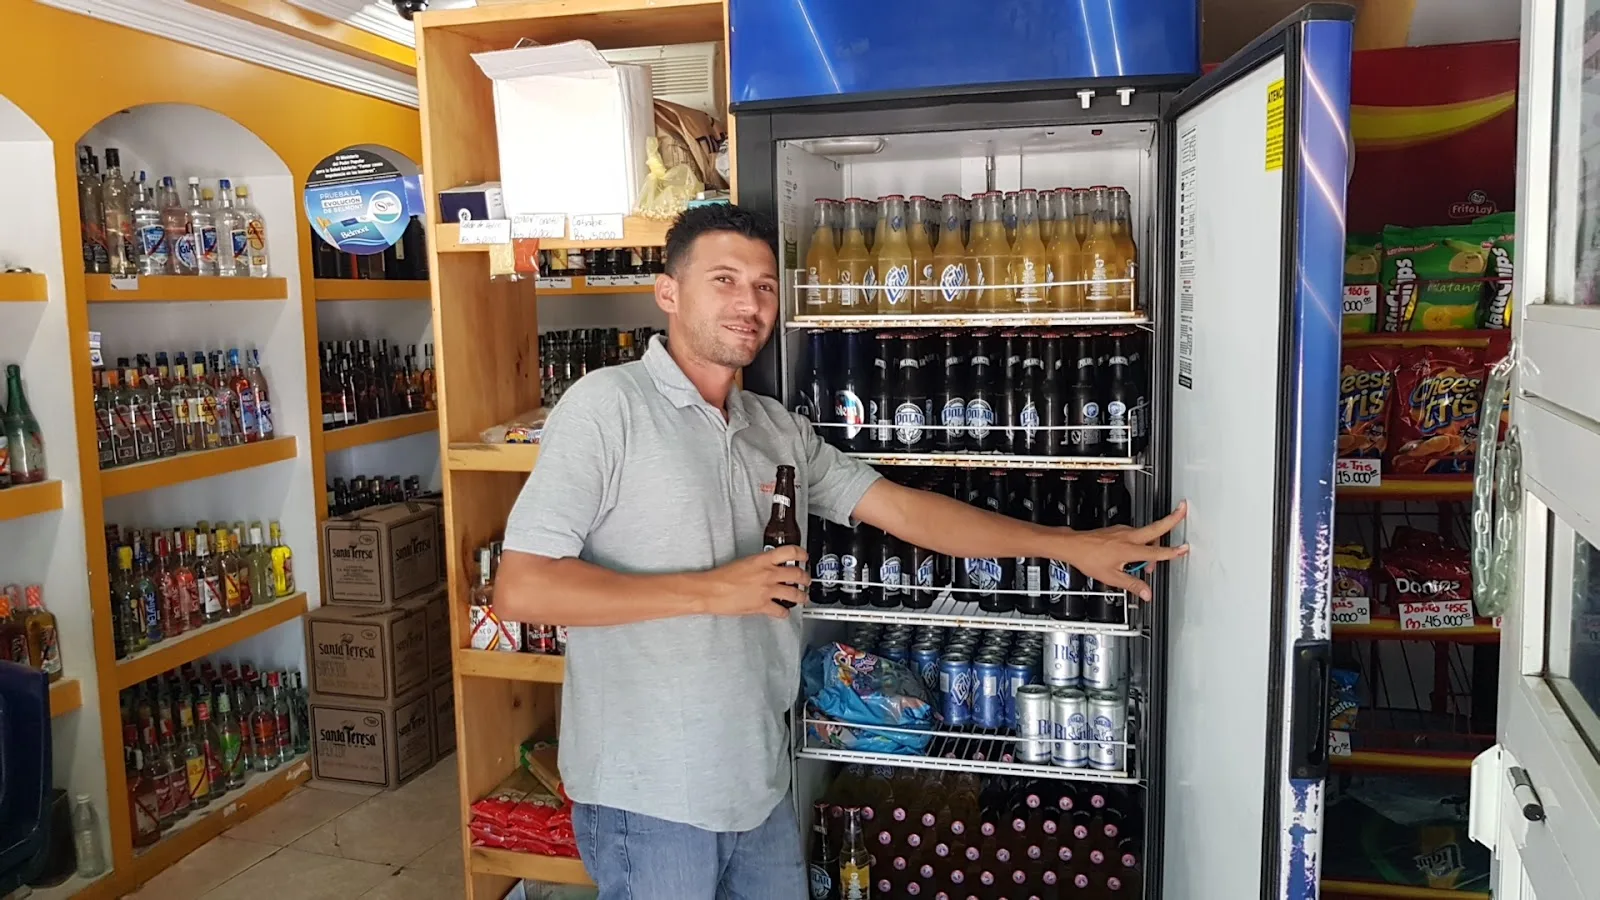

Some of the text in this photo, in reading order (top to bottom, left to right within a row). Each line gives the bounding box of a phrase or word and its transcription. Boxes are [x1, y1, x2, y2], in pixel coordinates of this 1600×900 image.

[320, 190, 349, 200] PRUEBA
[323, 198, 361, 207] EVOLUCIÓN
[332, 204, 363, 213] BELMONT
[340, 225, 370, 239] Belmont
[332, 544, 373, 560] Santa Teresa
[1396, 578, 1460, 595] Doritos
[319, 640, 376, 658] Santa Teresa
[320, 725, 376, 746] Santa Teresa
